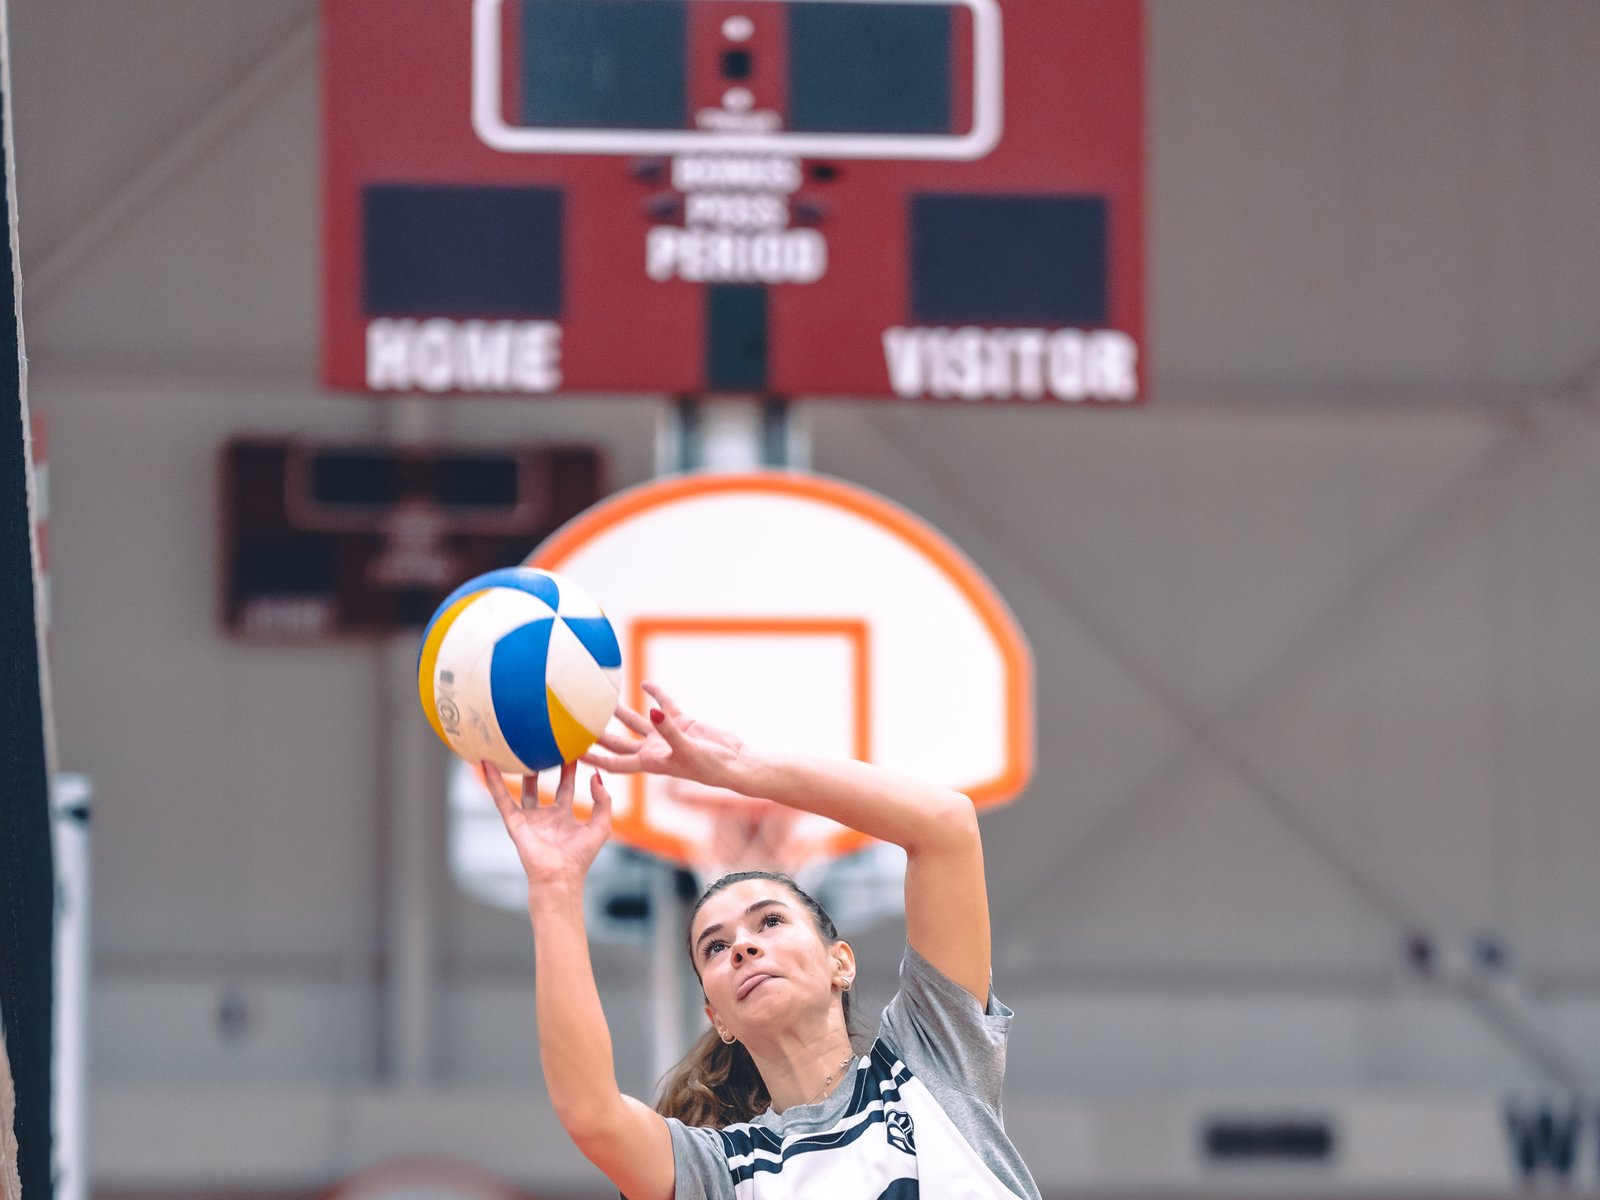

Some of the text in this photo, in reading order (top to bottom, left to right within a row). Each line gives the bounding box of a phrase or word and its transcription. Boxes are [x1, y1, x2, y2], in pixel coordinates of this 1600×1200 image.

[646, 227, 827, 282] PERIOD
[367, 319, 562, 391] HOME
[882, 327, 1138, 401] VISITOR
